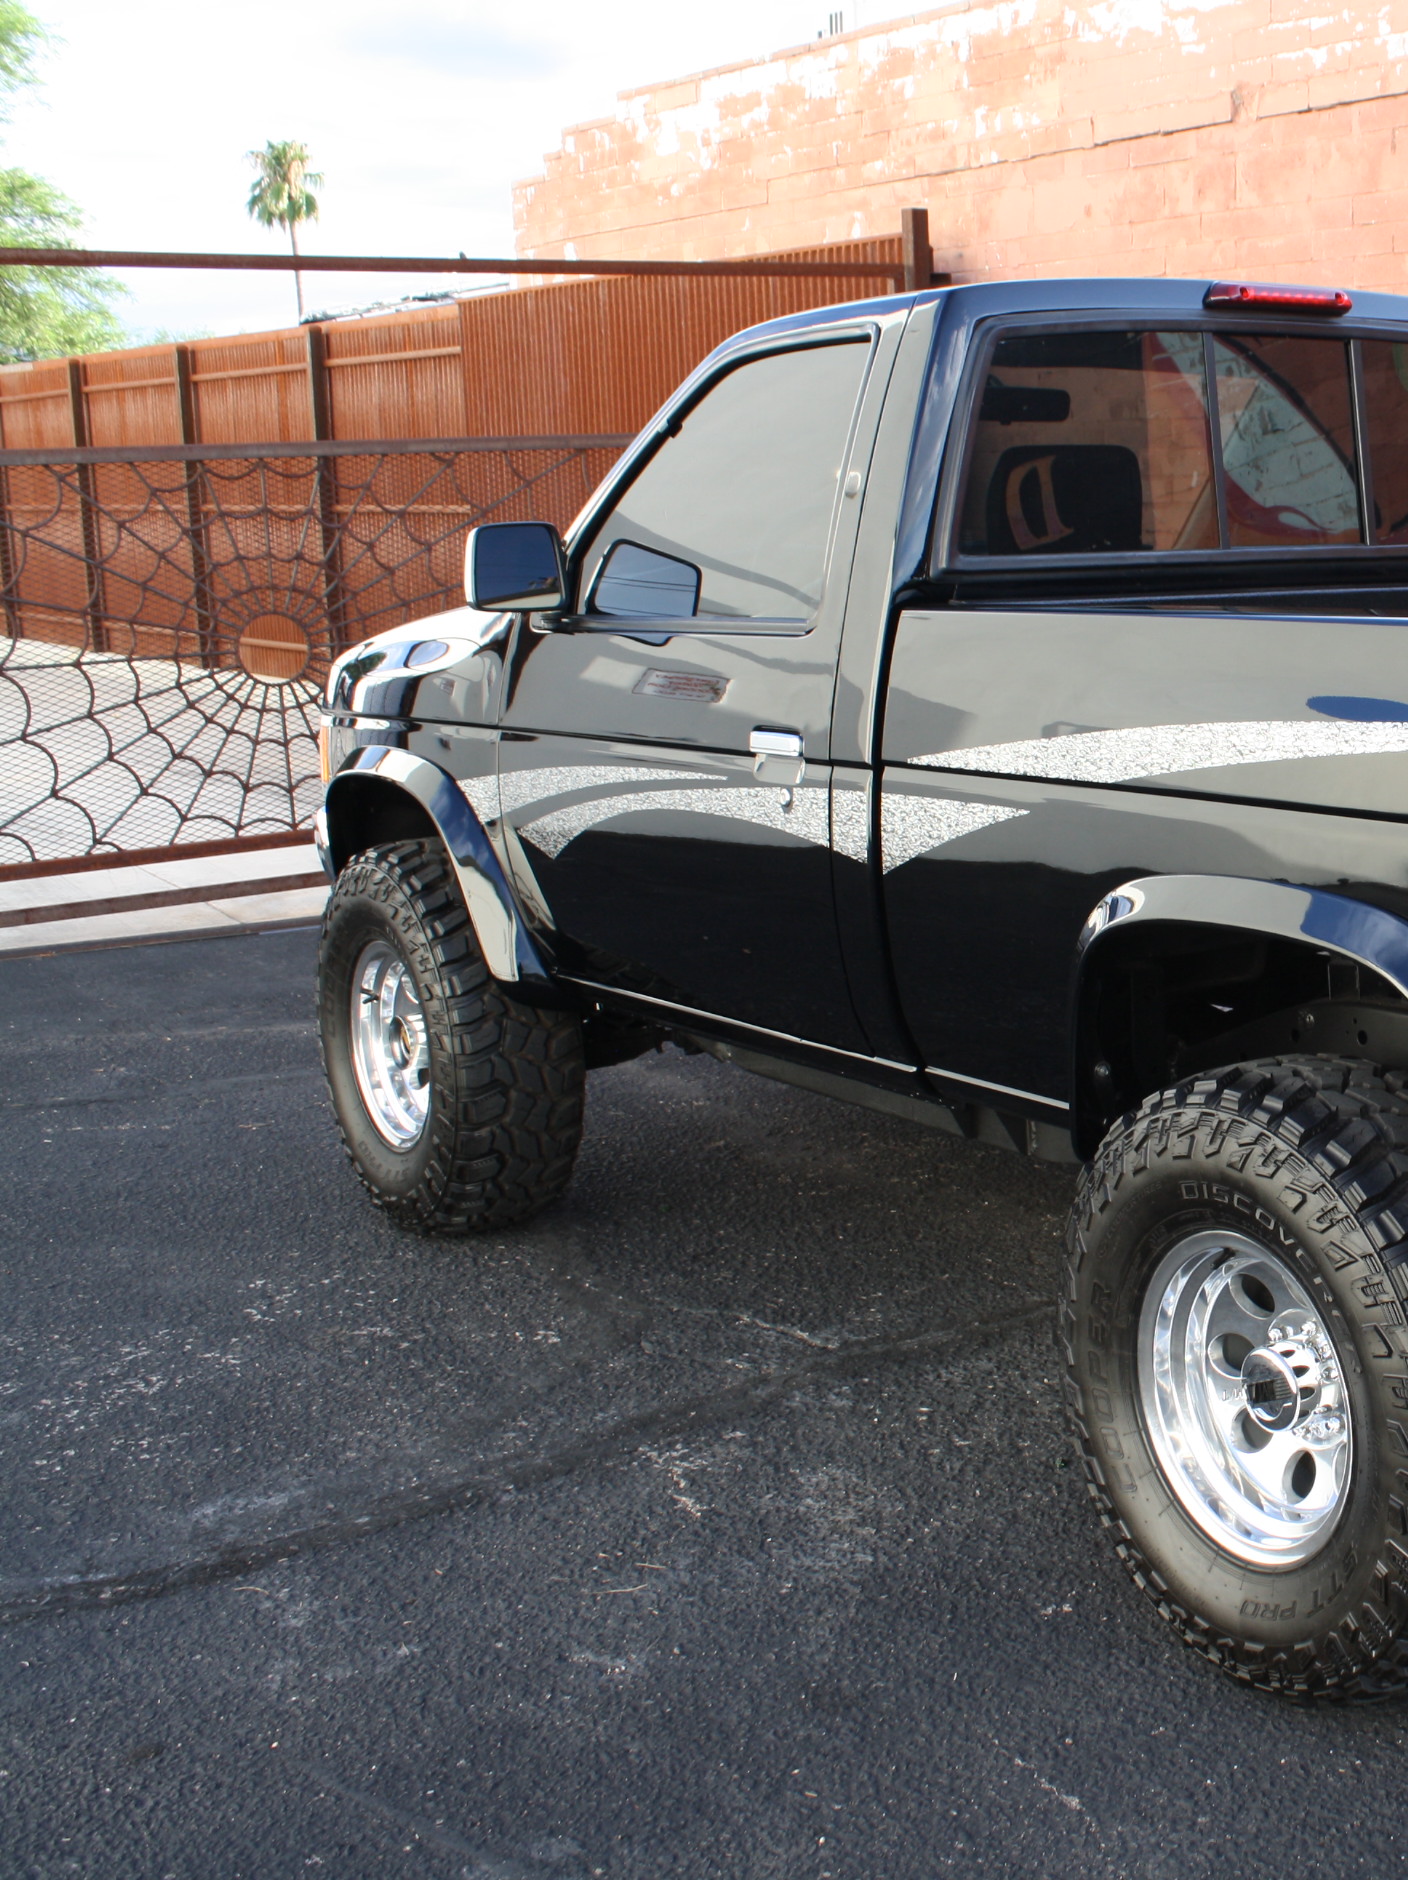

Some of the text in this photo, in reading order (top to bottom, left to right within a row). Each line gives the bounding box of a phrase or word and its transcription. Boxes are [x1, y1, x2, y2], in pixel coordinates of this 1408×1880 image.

[1087, 1278, 1138, 1492] COOPER
[1239, 1543, 1358, 1622] STT PRO
